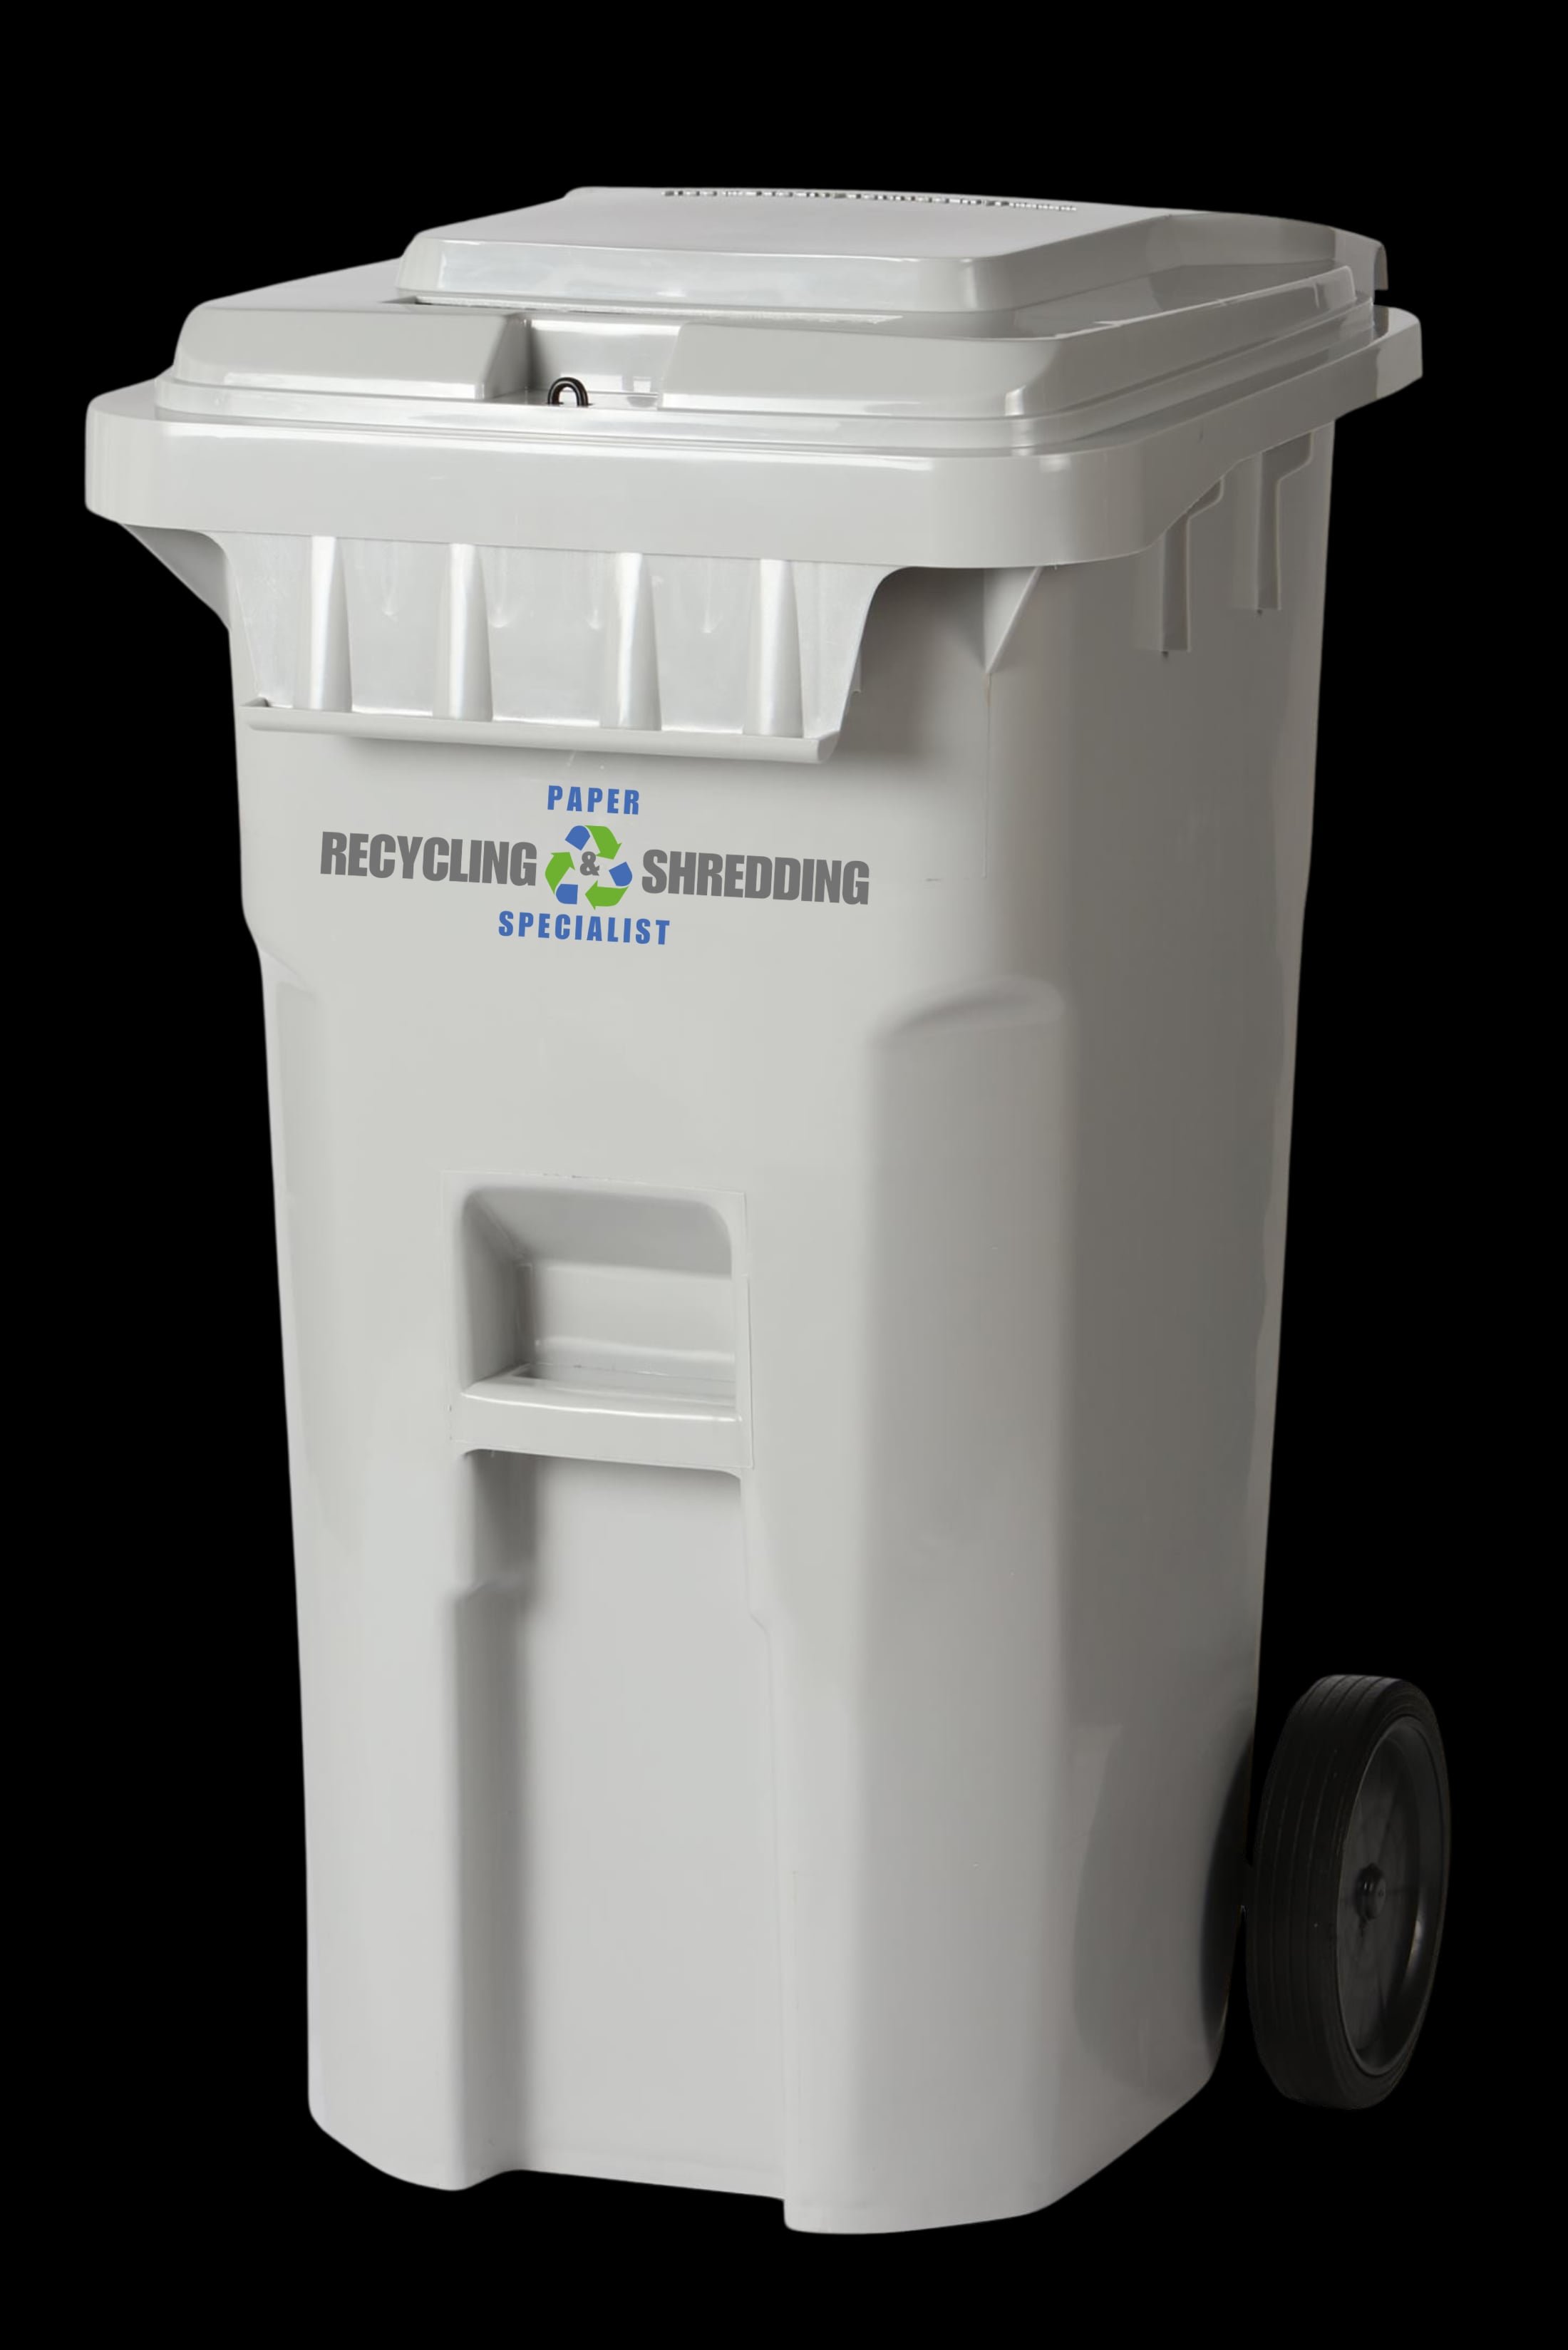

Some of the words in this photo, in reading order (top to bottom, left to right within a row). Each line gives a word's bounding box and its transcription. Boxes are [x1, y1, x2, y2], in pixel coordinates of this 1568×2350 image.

[547, 785, 640, 815] PAPER
[320, 831, 537, 887] RECYCLING
[579, 850, 600, 876] &
[641, 849, 870, 905] SHREDDING
[498, 910, 671, 946] SPECIALIST
